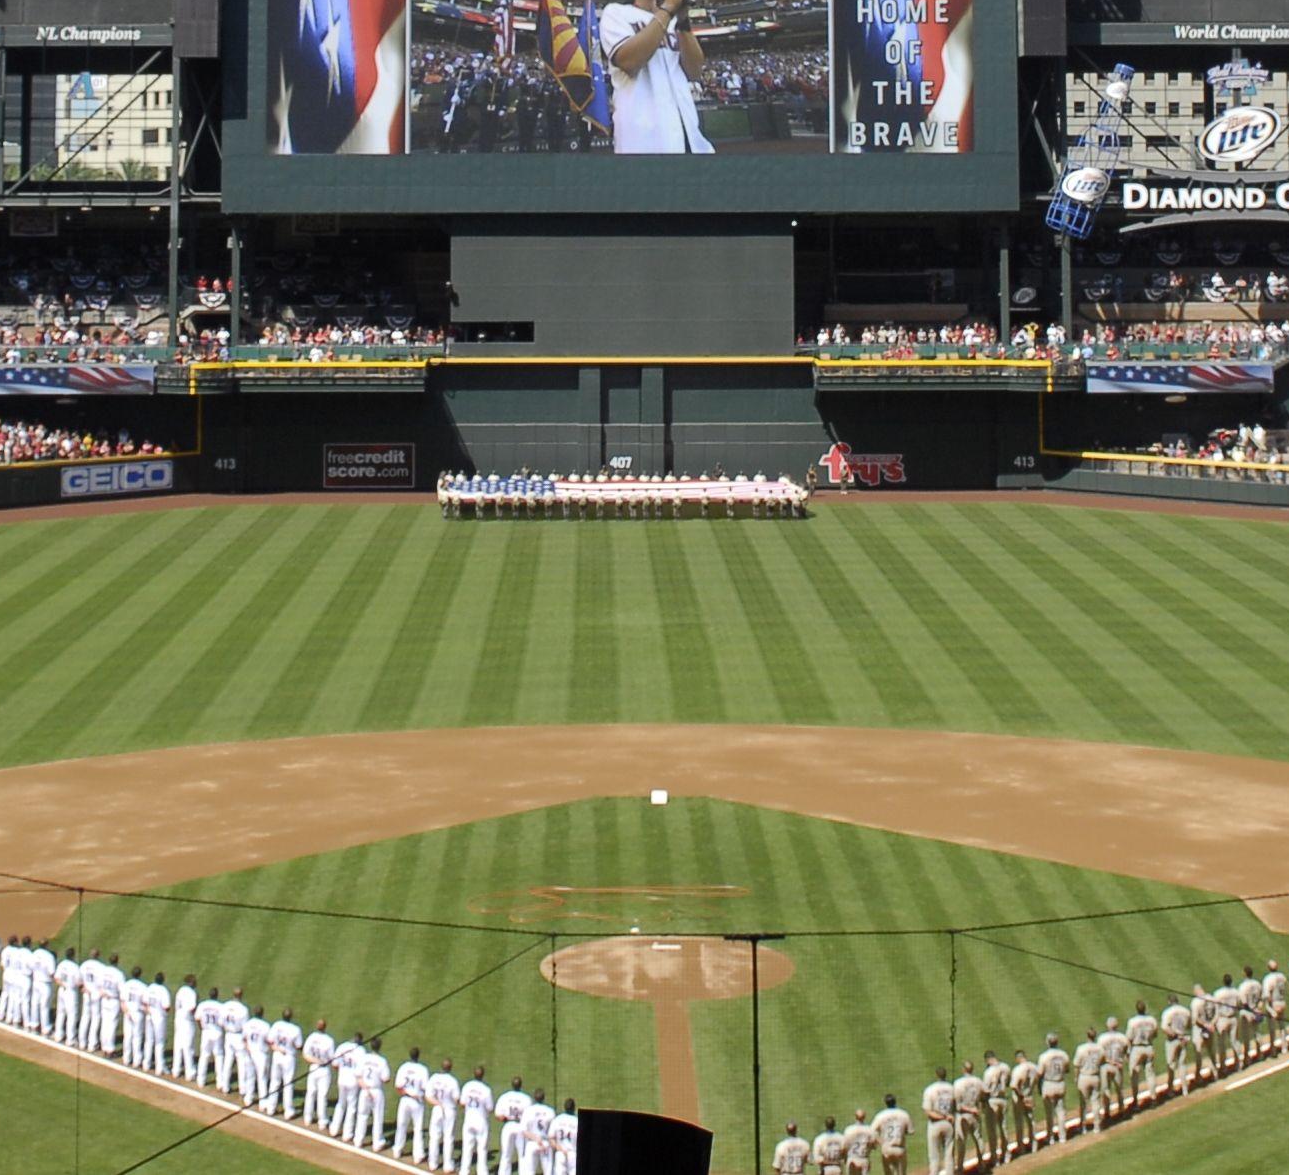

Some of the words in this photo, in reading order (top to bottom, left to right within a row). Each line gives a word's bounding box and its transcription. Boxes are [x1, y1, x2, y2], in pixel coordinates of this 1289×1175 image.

[36, 26, 59, 42] NL
[60, 26, 142, 44] Champions
[1175, 25, 1219, 40] World
[885, 39, 922, 65] OF
[872, 80, 935, 106] THE
[849, 121, 960, 147] BRAVE
[1217, 122, 1267, 154] Lite
[1123, 182, 1266, 210] DIAMOND
[215, 458, 236, 470] 413
[327, 449, 406, 465] freecredit
[610, 457, 632, 469] 407
[1014, 456, 1035, 468] 413
[63, 464, 172, 493] GEICO
[327, 466, 409, 478] score.com
